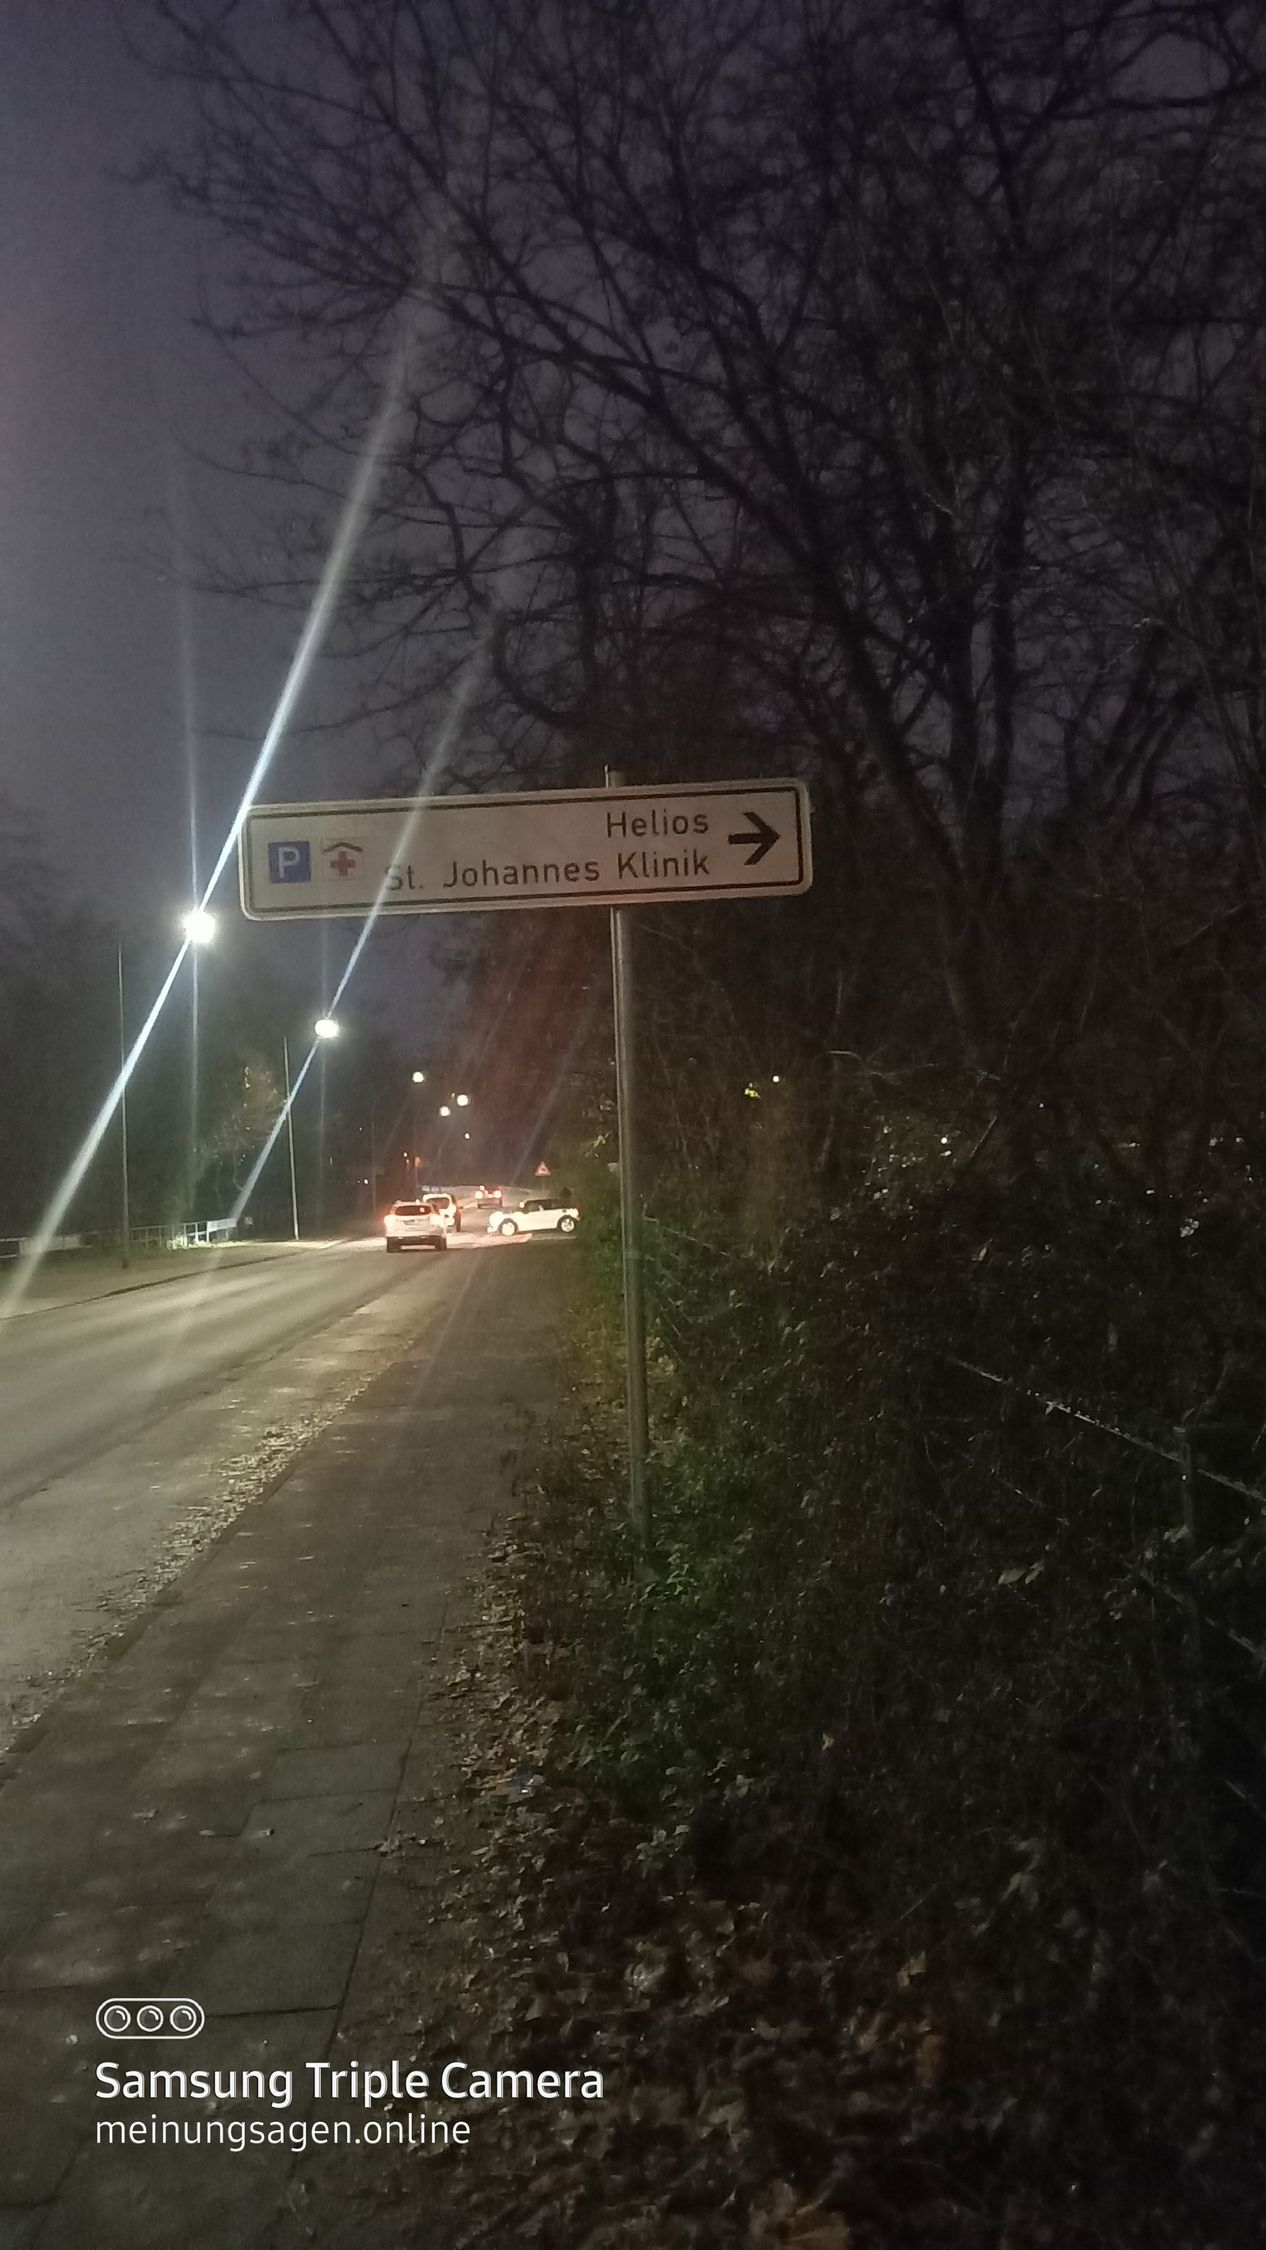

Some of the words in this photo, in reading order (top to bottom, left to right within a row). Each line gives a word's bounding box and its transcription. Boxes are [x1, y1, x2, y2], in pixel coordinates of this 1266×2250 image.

[606, 810, 709, 838] Helios
[277, 845, 301, 879] P
[384, 863, 424, 891] St.
[443, 857, 600, 888] Johannes
[617, 849, 710, 879] Klinik
